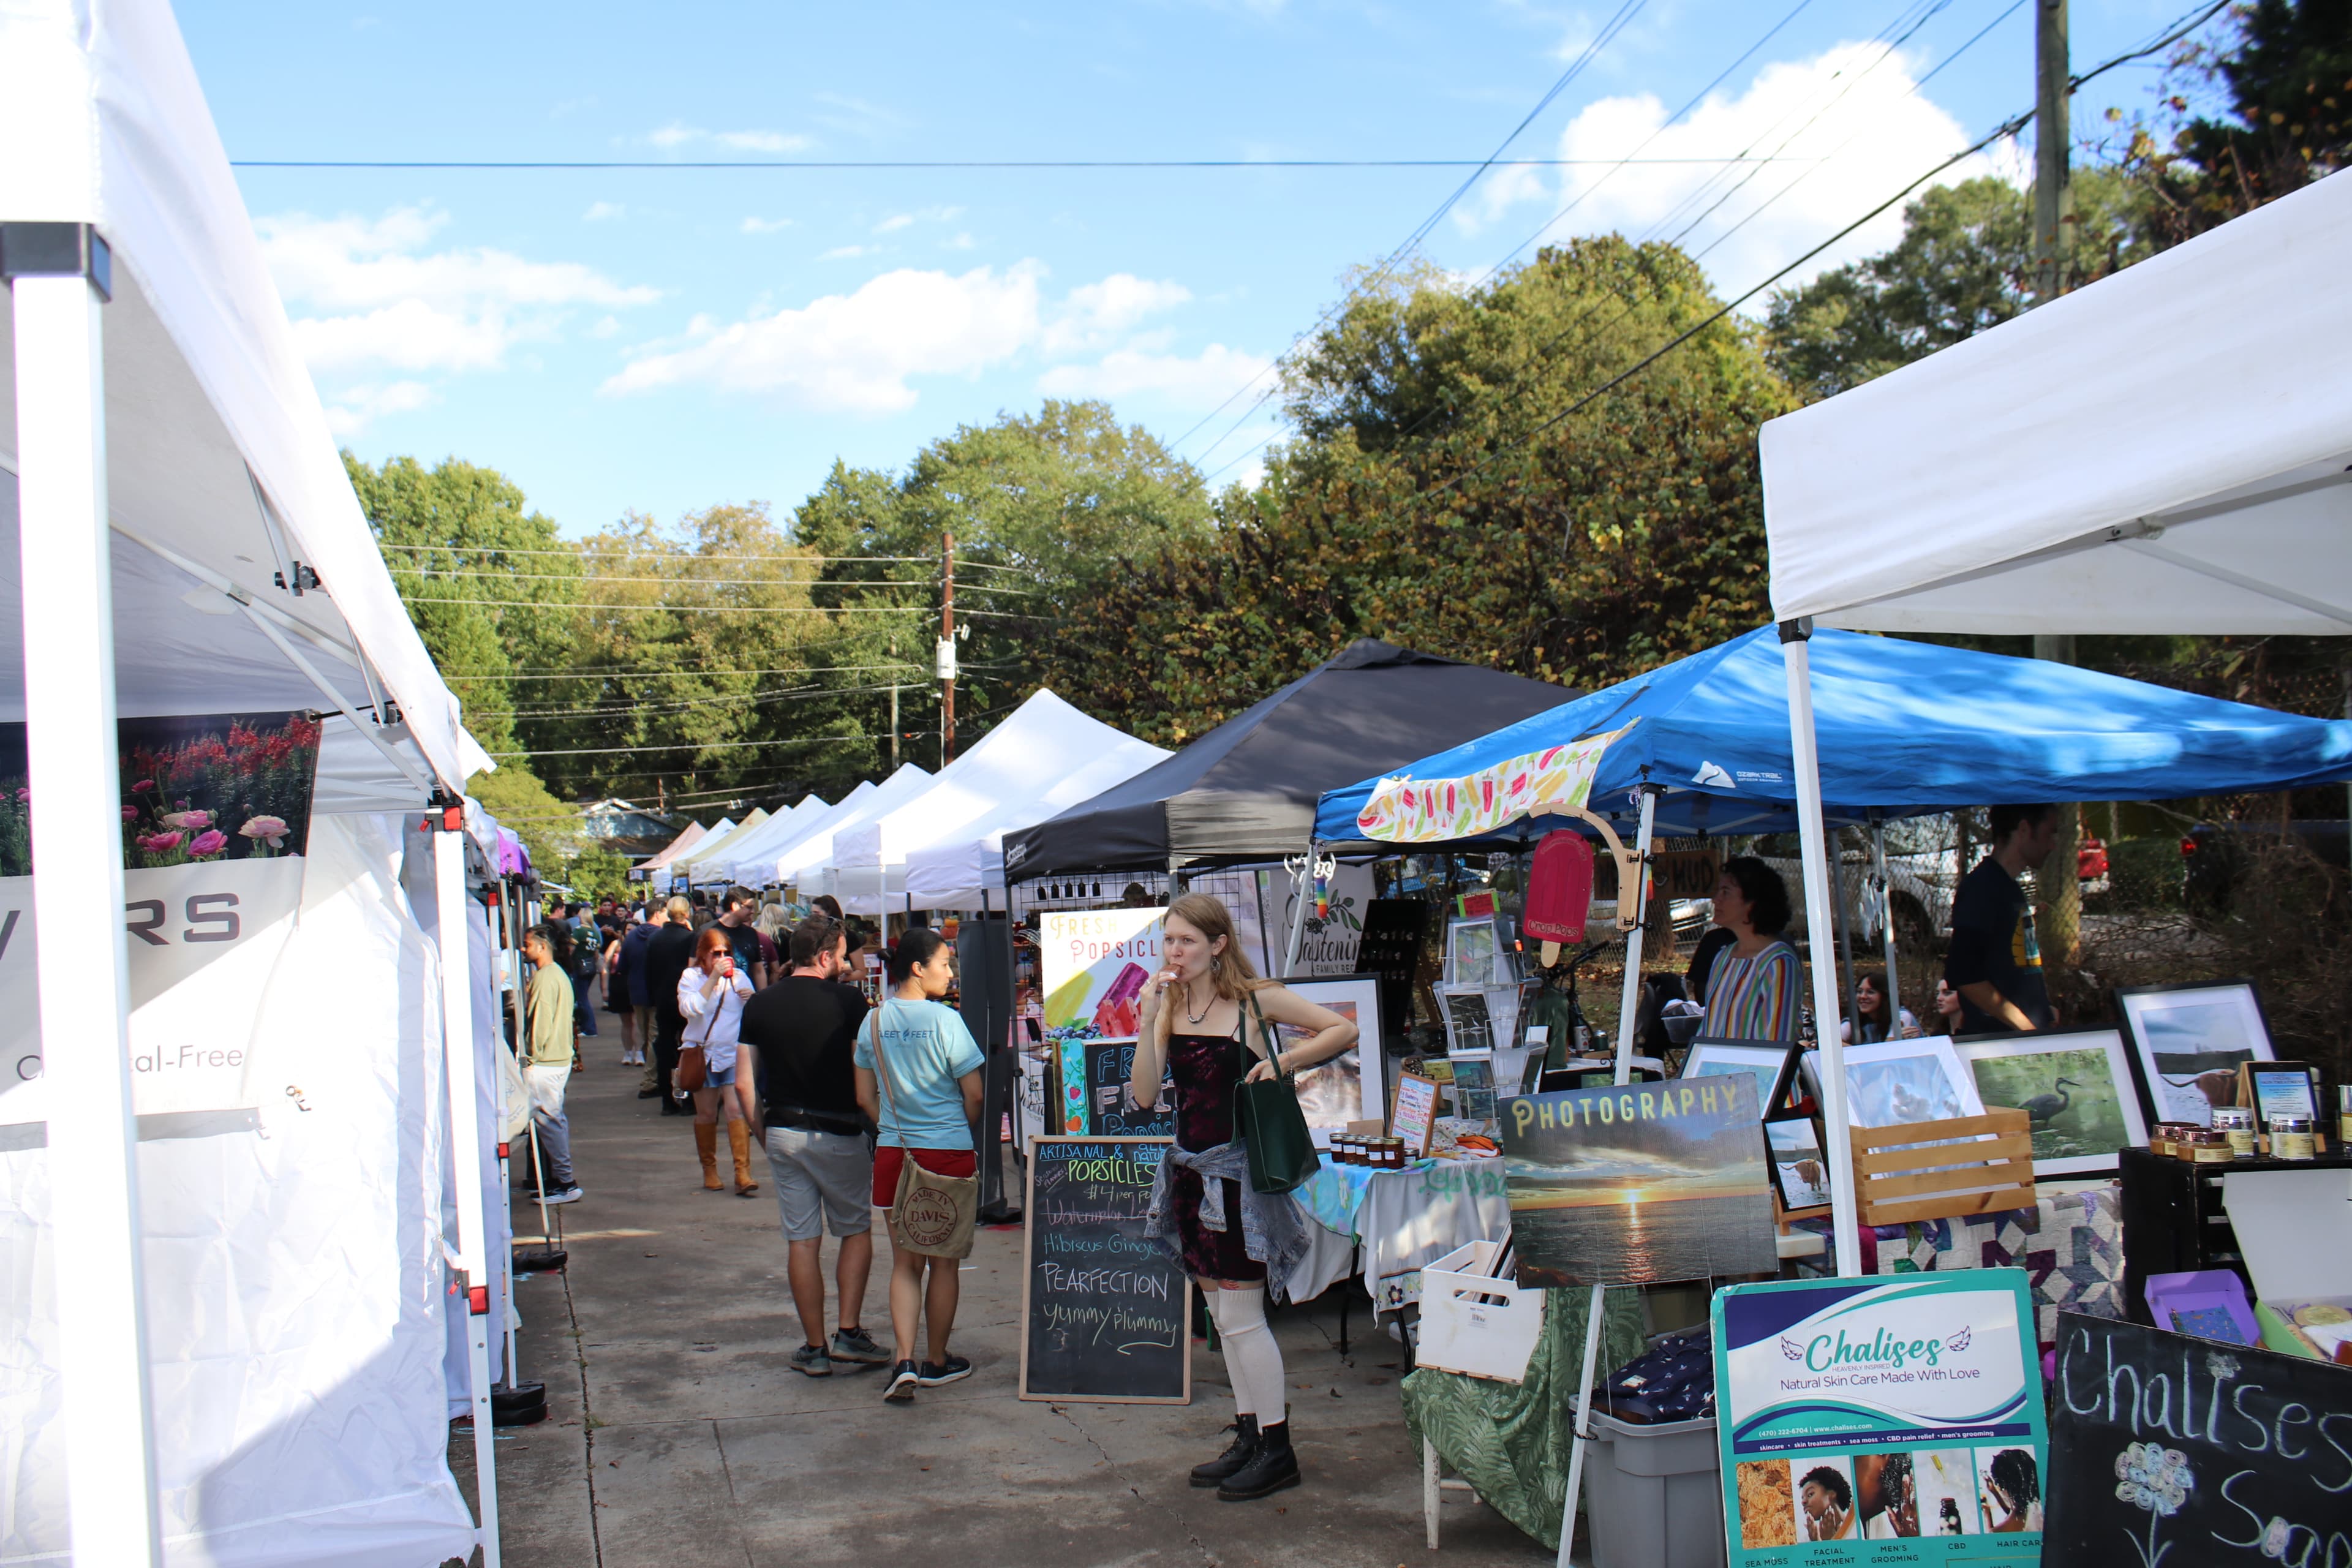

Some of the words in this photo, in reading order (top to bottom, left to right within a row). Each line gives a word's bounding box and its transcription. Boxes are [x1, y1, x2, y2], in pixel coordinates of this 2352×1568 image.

[1050, 914, 1117, 940] FRESH
[1529, 921, 1553, 934] Crop
[1555, 923, 1578, 936] Pops
[1070, 939, 1157, 963] POPSICL
[1316, 964, 1339, 973] FAMILY
[1341, 963, 1355, 973] REC
[1512, 1084, 1737, 1138] PHOTOGRAPHY
[1102, 1110, 1177, 1136] Popsicl
[1039, 1144, 1106, 1159] ARTISANAL
[1114, 1144, 1123, 1159] &
[1068, 1156, 1156, 1186] POPSICLES
[912, 1189, 935, 1203] MADE
[937, 1195, 948, 1205] IN
[1084, 1183, 1114, 1202] $4
[1116, 1191, 1133, 1204] per
[1139, 1190, 1152, 1204] po
[911, 1210, 950, 1223] DAVIS
[908, 1223, 954, 1243] CALIFORNIA
[1043, 1232, 1103, 1255] Hibiscus
[1037, 1260, 1169, 1302] PEARFECTION
[1806, 1326, 1945, 1372] Chalises
[1780, 1376, 1821, 1390] Natural
[1823, 1374, 1848, 1387] Skin
[1850, 1374, 1878, 1385] Care
[1881, 1371, 1914, 1384] Made
[1917, 1368, 1947, 1381] With
[1950, 1368, 1980, 1379] Love
[2062, 1327, 2352, 1493] Chalises
[1814, 1423, 1872, 1433] www.chalises.com
[1962, 1430, 1994, 1439] grooming
[1814, 1547, 1845, 1556] FACIAL
[1871, 1554, 1919, 1564] GROOMING
[1764, 1558, 1789, 1566] MOSS
[1804, 1557, 1856, 1567] TREATMENT
